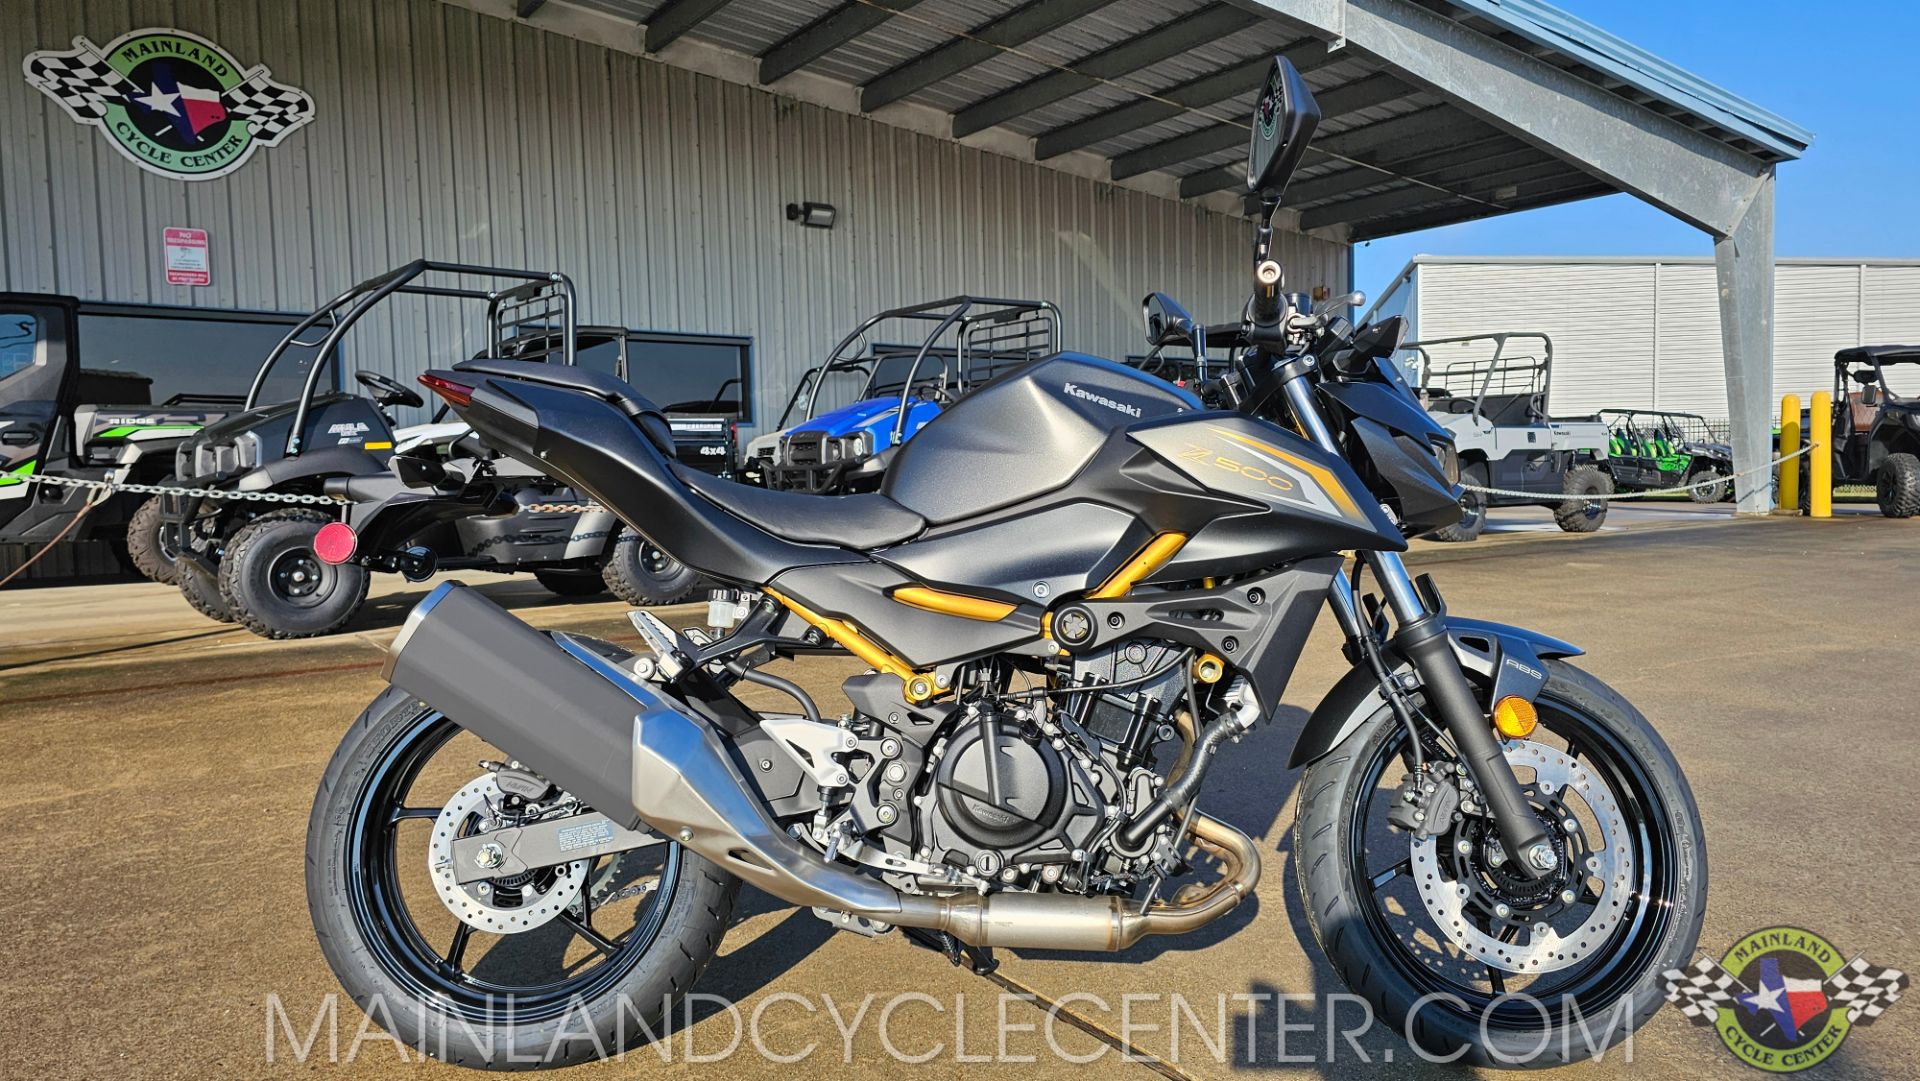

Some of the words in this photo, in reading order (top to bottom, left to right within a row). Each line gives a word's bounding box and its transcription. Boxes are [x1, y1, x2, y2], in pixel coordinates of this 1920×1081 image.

[121, 40, 229, 77] MAINLAND
[116, 121, 172, 164] CYCLE
[180, 134, 243, 168] CENTER
[1063, 382, 1142, 418] Kawasaki
[700, 446, 726, 455] 4x4
[1506, 659, 1542, 680] ABS
